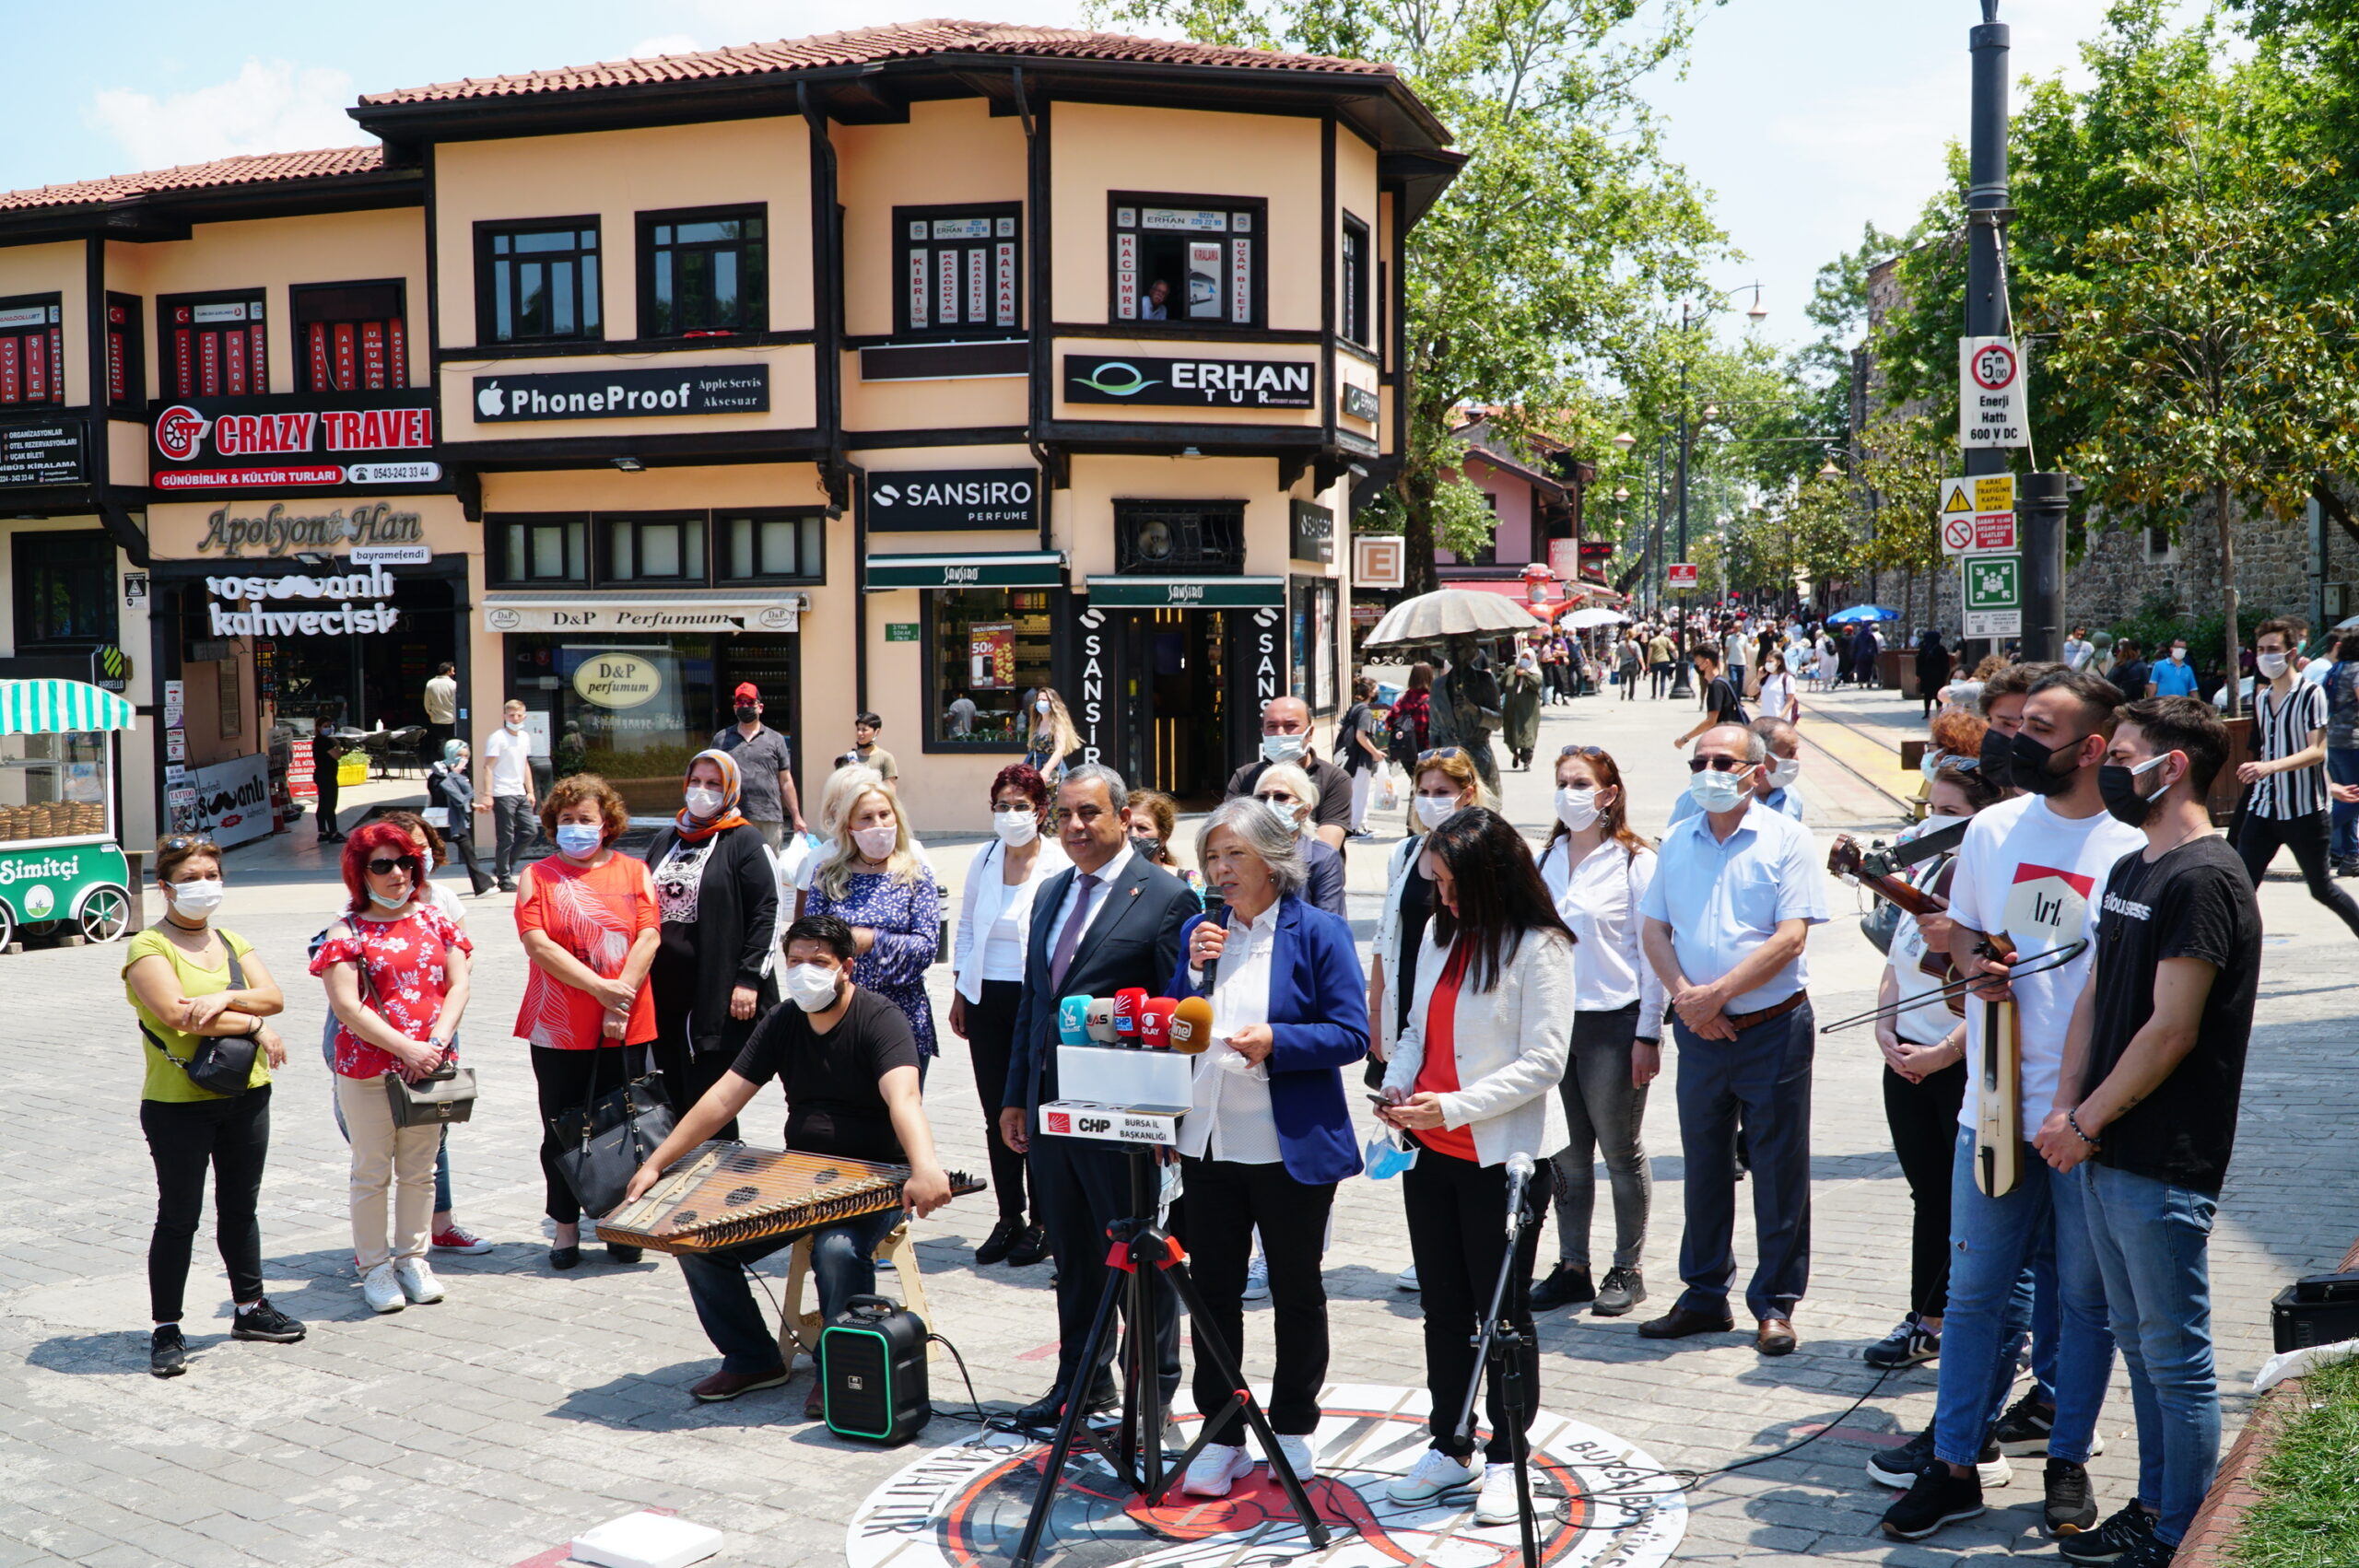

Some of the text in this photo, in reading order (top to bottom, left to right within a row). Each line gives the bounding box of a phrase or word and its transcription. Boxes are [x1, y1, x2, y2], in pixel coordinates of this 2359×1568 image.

[1147, 216, 1185, 224] ERHAN
[1121, 238, 1132, 269] HAC
[913, 258, 922, 314] KIBRIS
[943, 253, 953, 310] KAPADOKYA
[1001, 247, 1011, 312] BALKAN
[1121, 274, 1133, 316] UMRE
[31, 337, 40, 389] ŞİLE
[232, 337, 241, 392] SALDA
[315, 336, 323, 388] ADALAR
[341, 335, 349, 389] ABANT
[5, 343, 15, 400] AYVALIK
[1171, 362, 1309, 392] ERHAN
[698, 377, 761, 392] Apple Servis
[511, 382, 691, 415] PhoneProof
[703, 396, 757, 407] Aksesuar
[1204, 389, 1269, 404] TUR
[1979, 395, 2009, 408] Enerji
[1982, 412, 2007, 423] Hattı
[9, 428, 63, 439] ORGANİZASYONLAR
[216, 408, 433, 456] CRAZY TRAVEL
[1970, 427, 2018, 439] 600 V DC
[25, 439, 77, 449] REZERVASYONLARI
[28, 461, 76, 470] KİRALAMA
[374, 466, 429, 478] 0543-242 33 44
[161, 470, 336, 486] GÜNÜBİRLİK & KÜLTÜR TURLARI
[1977, 486, 2011, 494] TRAFİĞİNE
[968, 511, 1028, 521] PERFUME
[197, 501, 424, 557] Apolyont Han
[357, 550, 425, 561] bayramefendi
[1368, 548, 1391, 577] E
[209, 602, 391, 637] kahvecisi
[553, 611, 730, 628] D&P Perfumum
[600, 662, 637, 678] D&P
[588, 682, 650, 696] perfumum
[170, 790, 195, 801] TATTOO
[0, 855, 79, 884] Simitçi
[1142, 1027, 1160, 1036] OLAY
[1078, 1117, 1110, 1133] CHP
[1124, 1118, 1150, 1129] BURSA
[1120, 1130, 1167, 1141] BAŞKANLIĞI
[1565, 1441, 1647, 1491] BURSA
